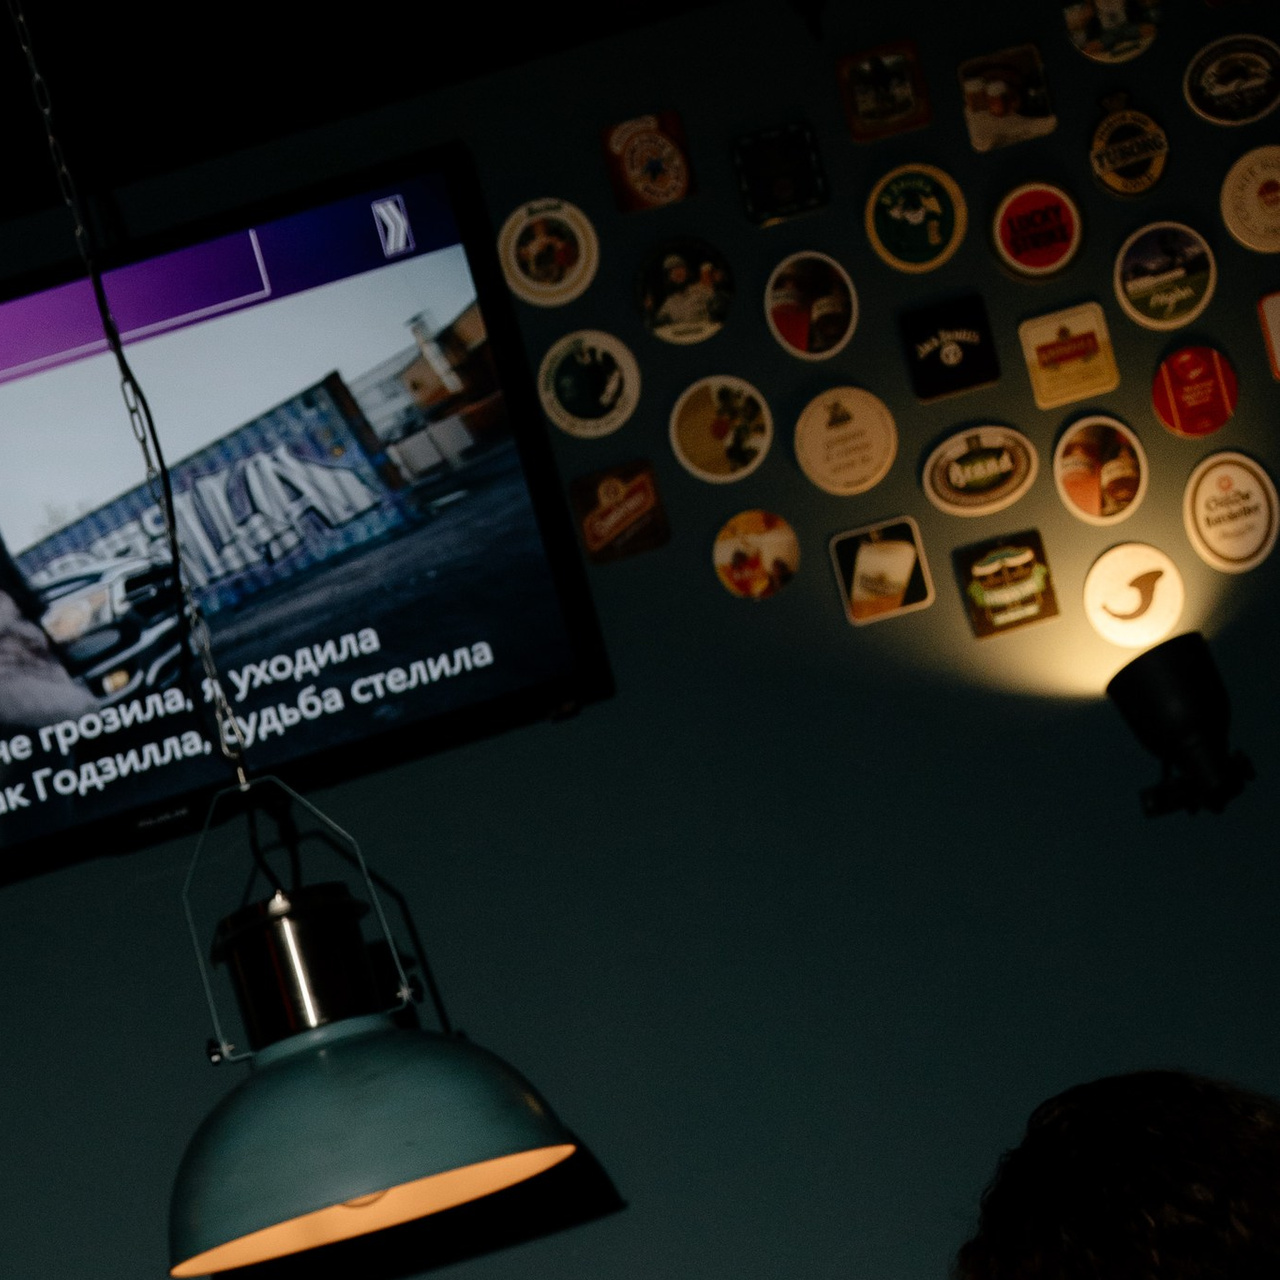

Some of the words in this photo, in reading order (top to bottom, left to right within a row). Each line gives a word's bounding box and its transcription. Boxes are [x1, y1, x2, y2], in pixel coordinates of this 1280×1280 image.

[31, 730, 212, 801] Годзилла,
[222, 684, 345, 749] судьба
[351, 641, 494, 704] стелила
[39, 687, 194, 756] грозила,
[228, 627, 381, 702] уходила
